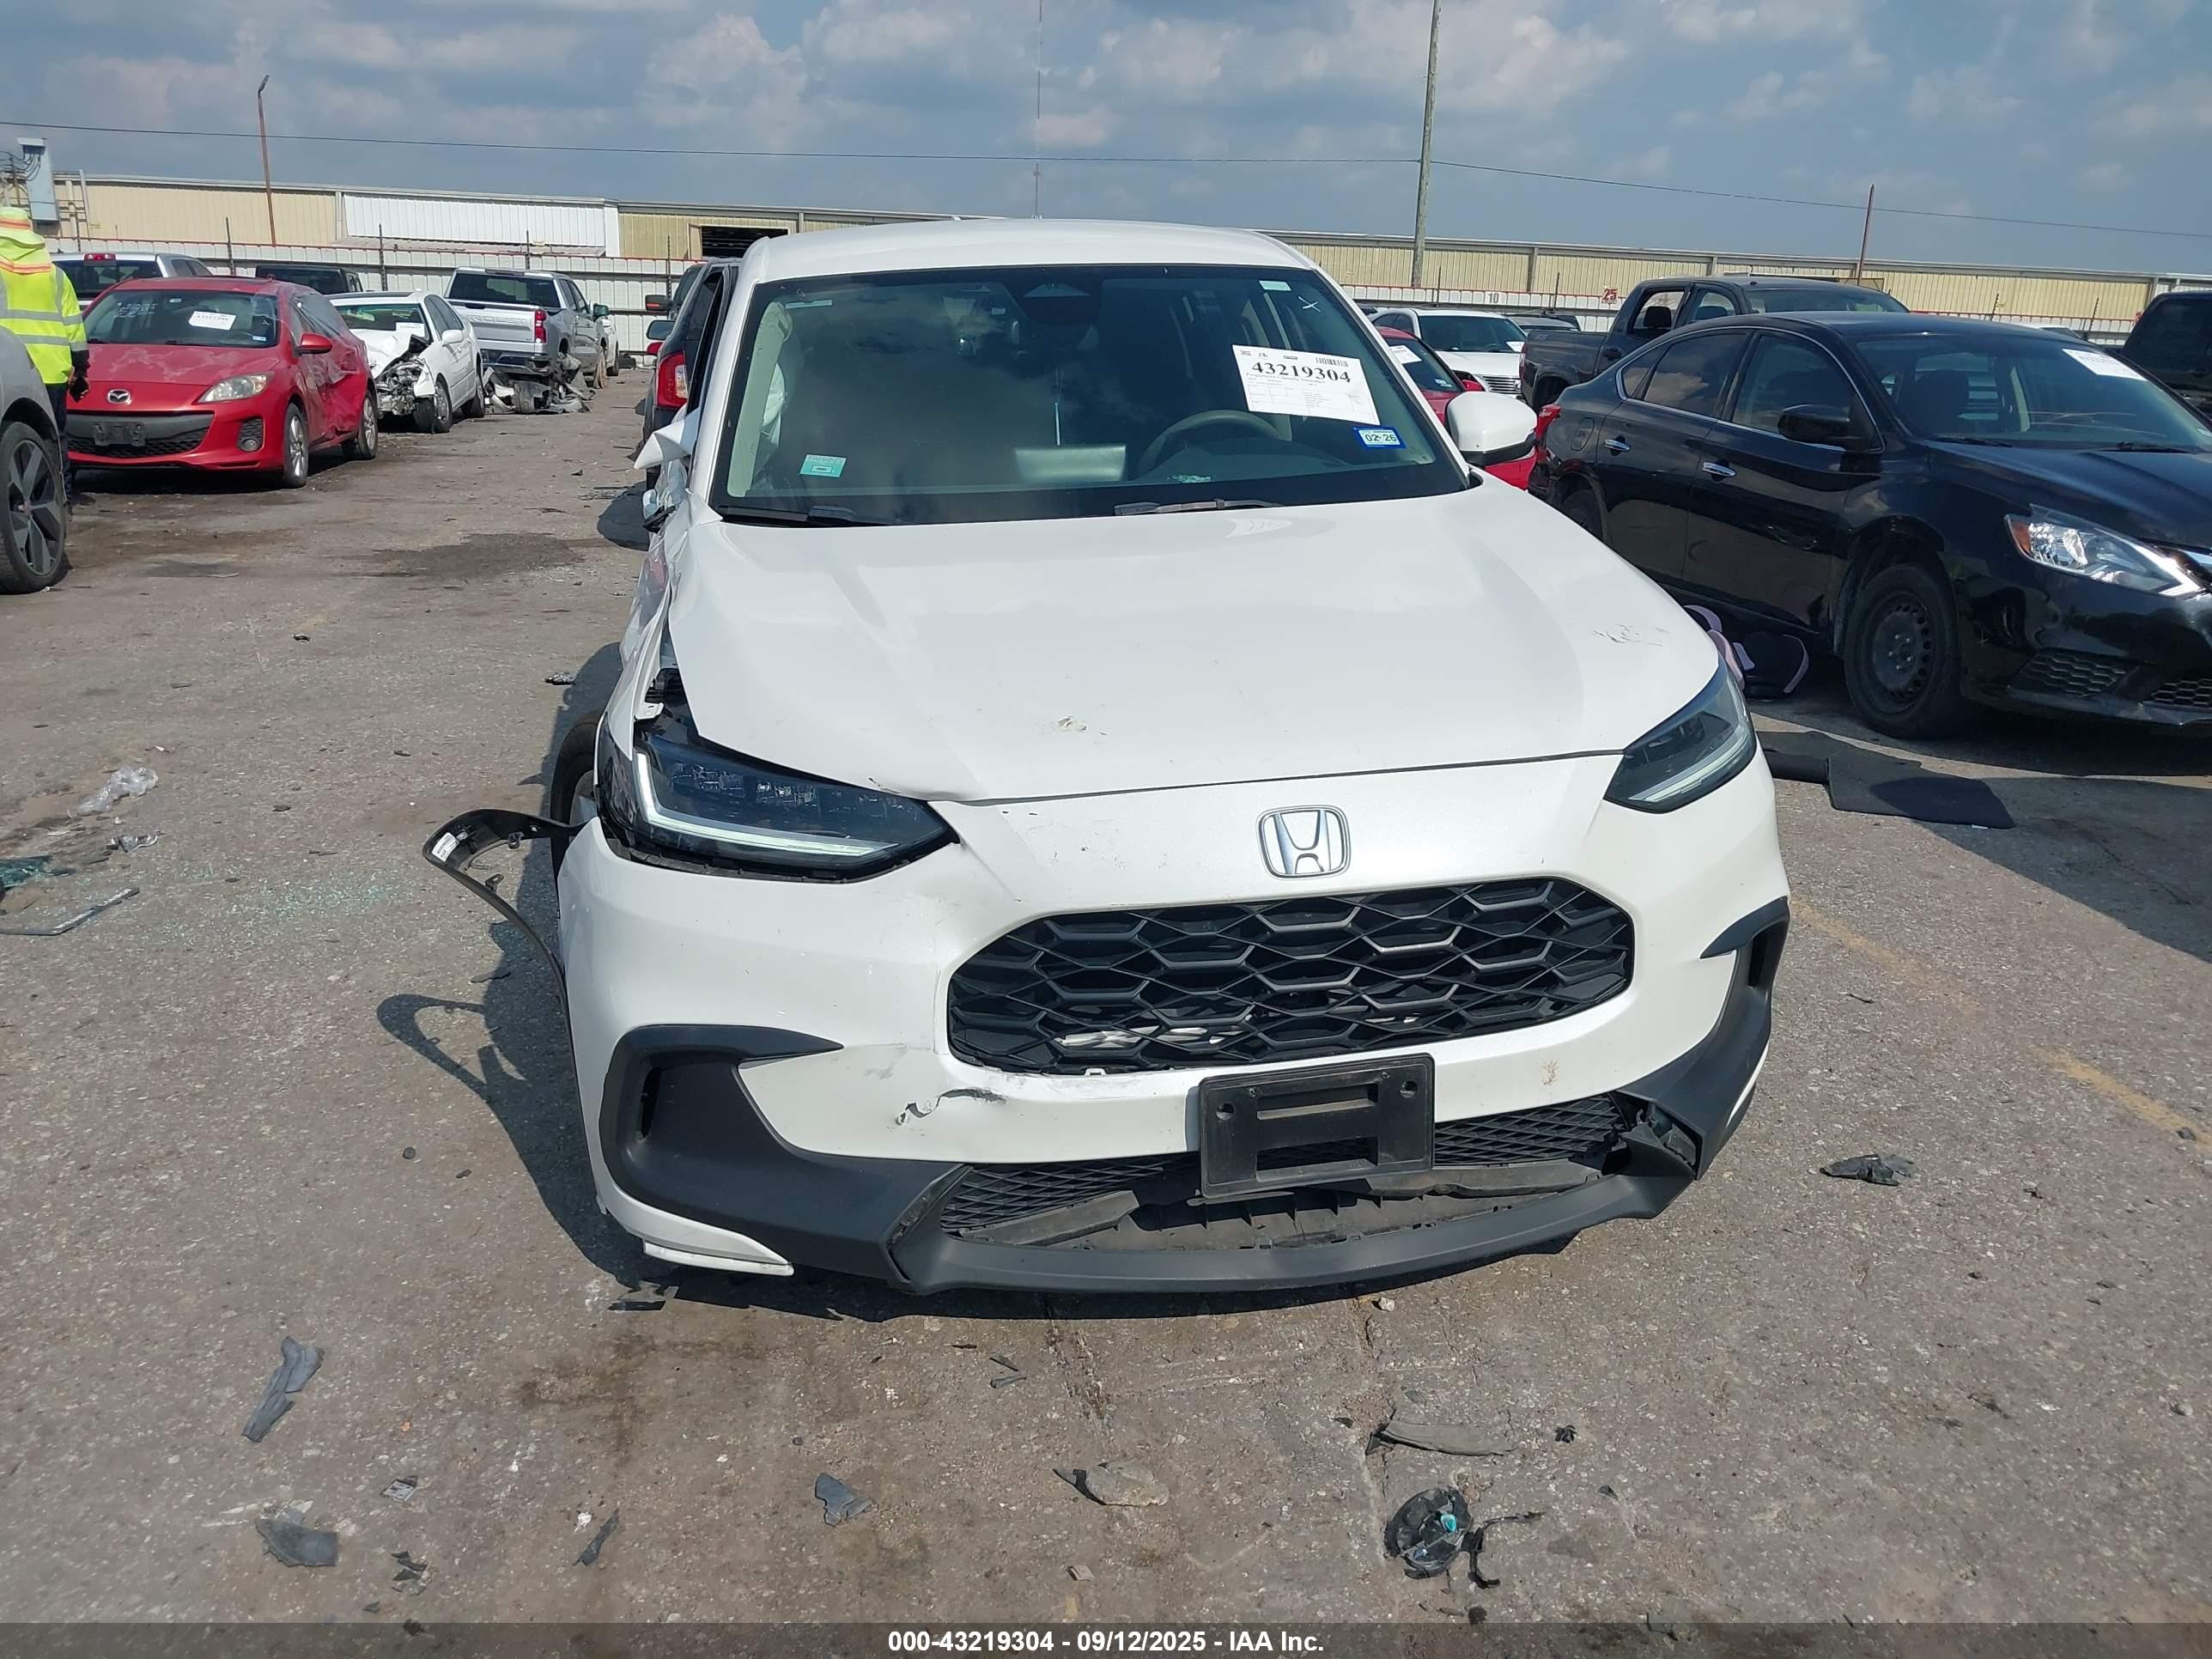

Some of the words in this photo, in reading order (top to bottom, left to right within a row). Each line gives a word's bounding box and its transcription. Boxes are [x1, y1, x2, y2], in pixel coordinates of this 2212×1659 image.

[1488, 293, 1499, 304] 10
[1602, 288, 1618, 301] 25
[1252, 362, 1351, 383] 43219304
[1365, 434, 1379, 442] 02
[1382, 434, 1397, 442] 26
